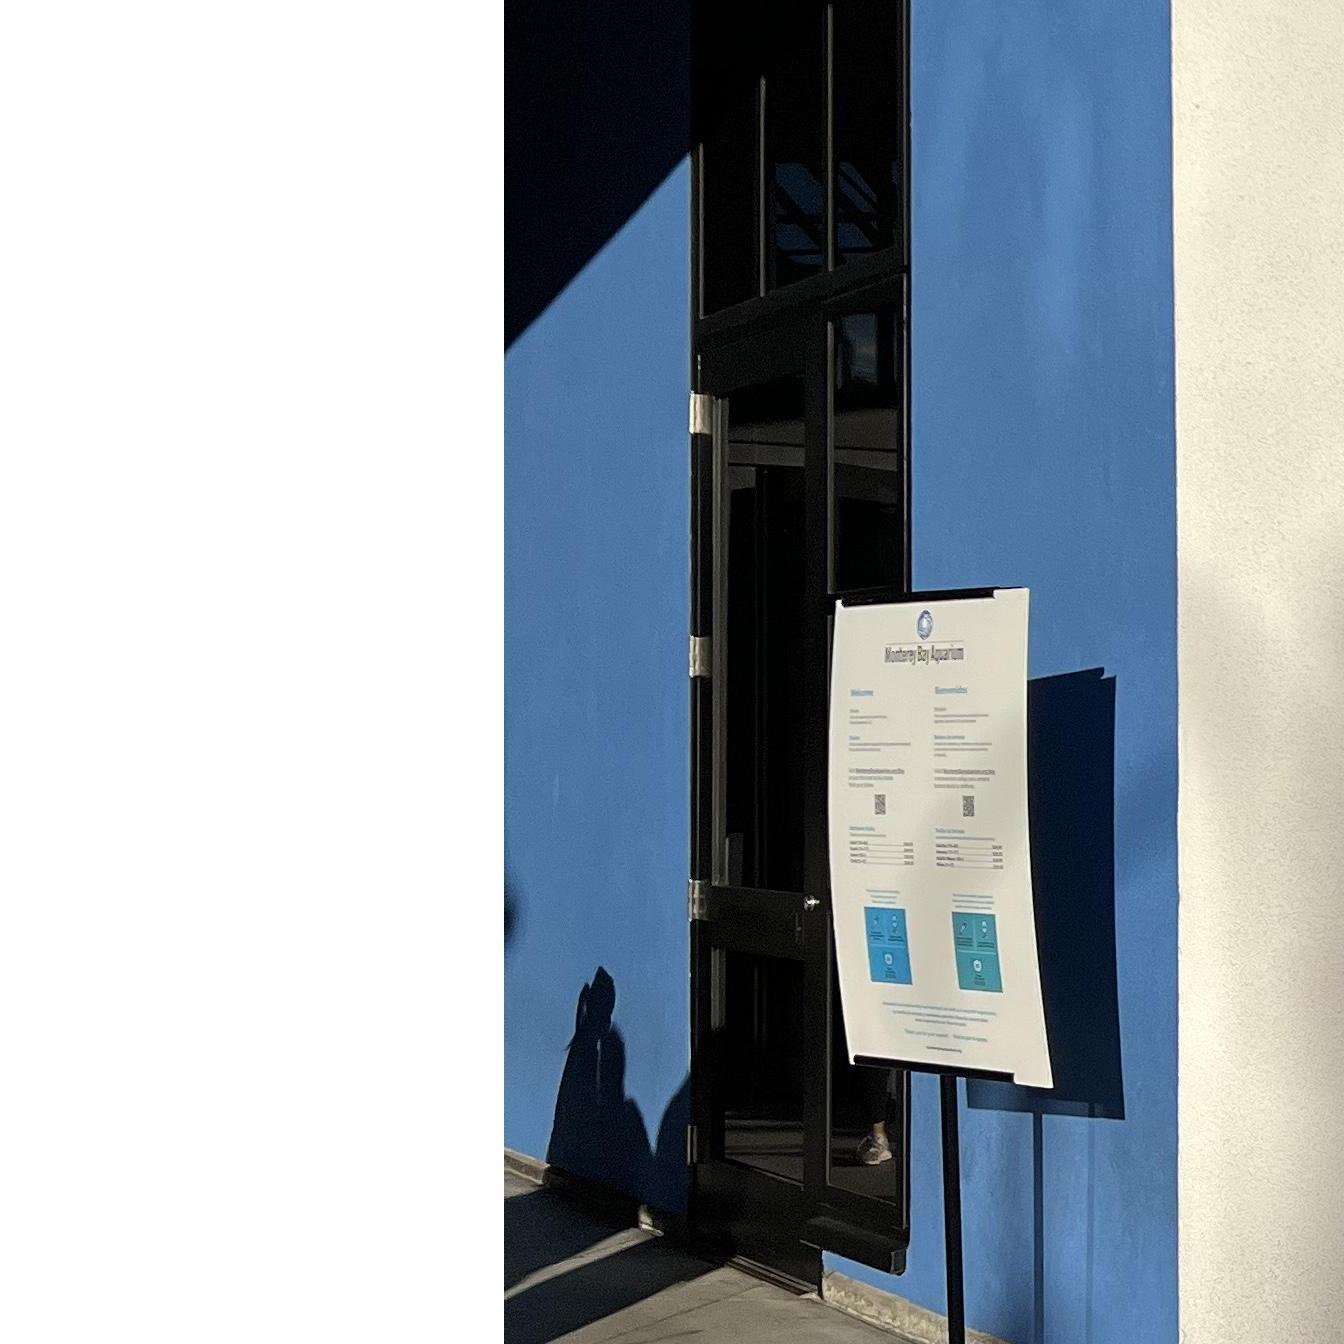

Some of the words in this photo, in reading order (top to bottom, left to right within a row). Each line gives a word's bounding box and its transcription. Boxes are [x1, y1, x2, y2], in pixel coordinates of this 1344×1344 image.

[884, 646, 916, 665] Monterey
[917, 645, 930, 665] Bay
[930, 643, 964, 664] Aquarium
